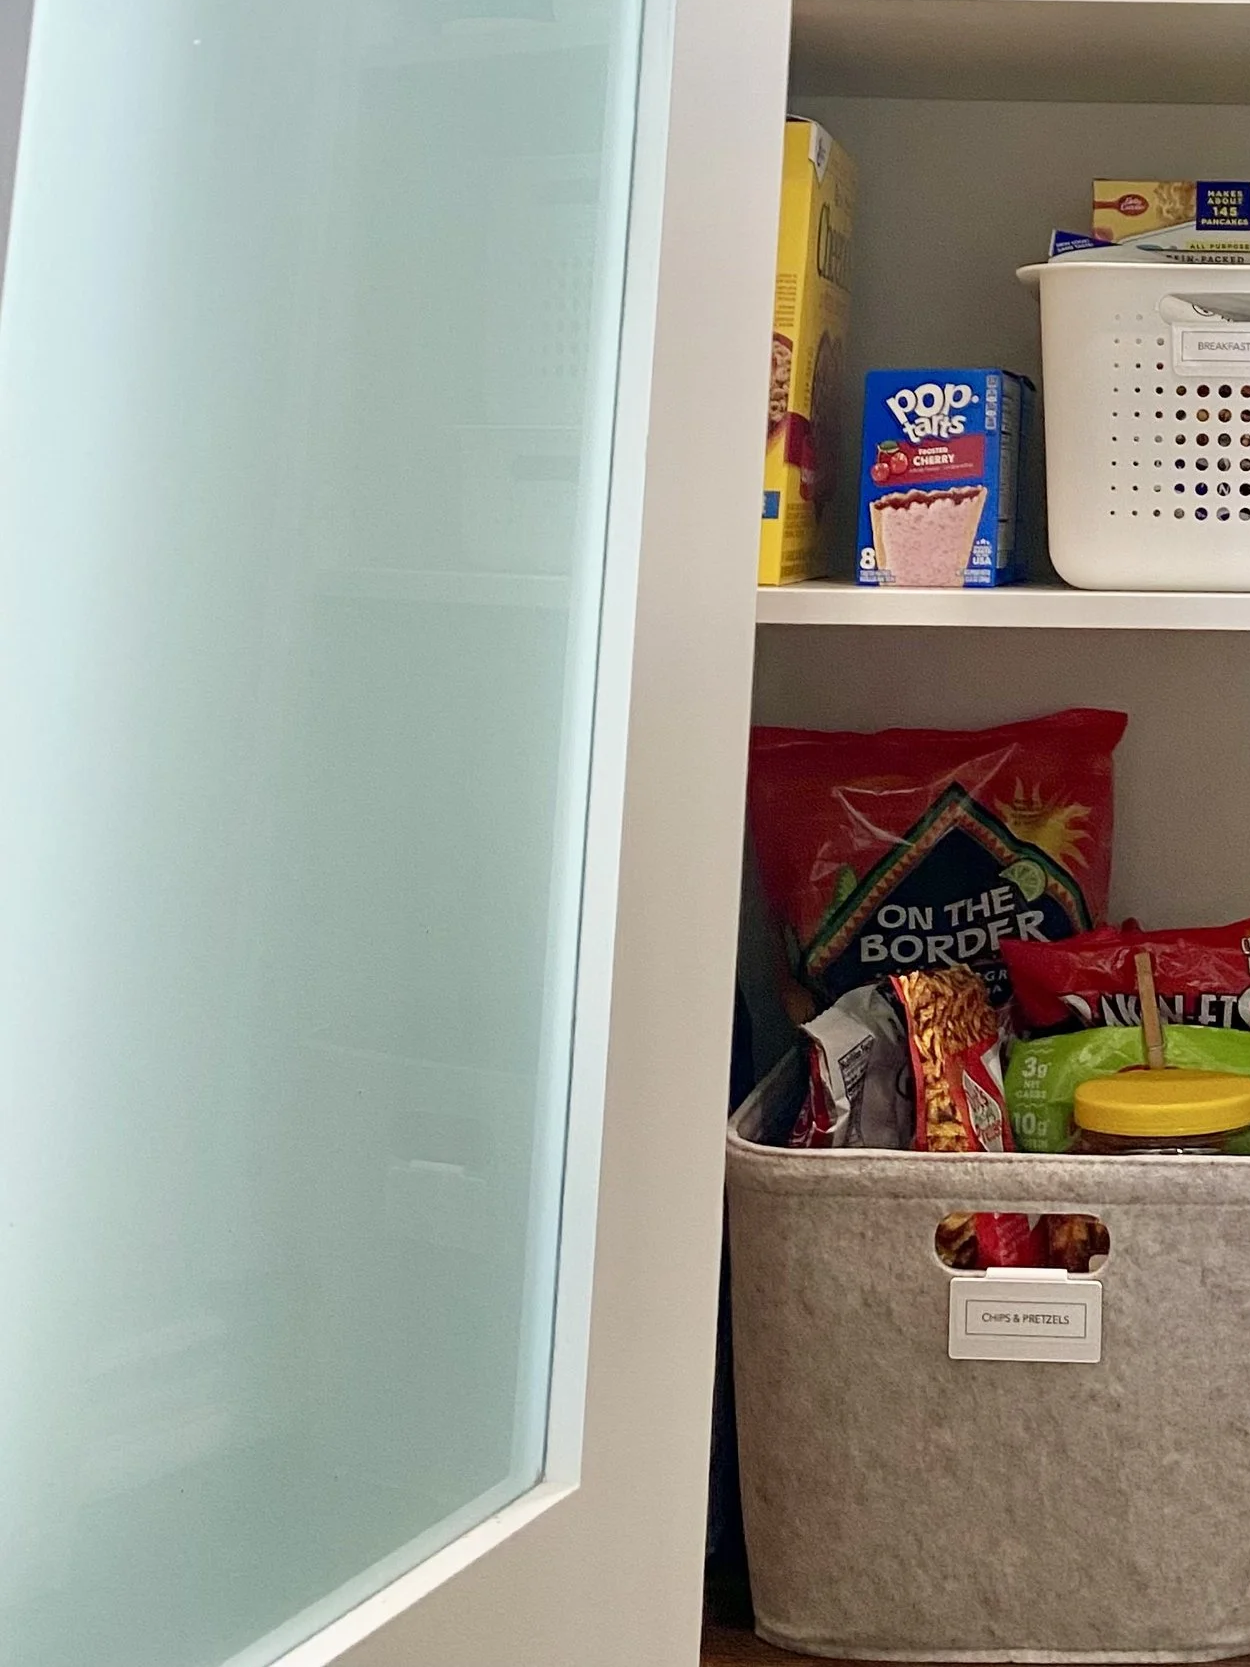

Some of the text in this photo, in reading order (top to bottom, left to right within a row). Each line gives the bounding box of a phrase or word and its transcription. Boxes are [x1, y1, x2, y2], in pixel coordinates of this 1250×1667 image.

[1207, 197, 1243, 205] ABOUT
[1213, 206, 1238, 216] 145
[1201, 218, 1249, 226] PANCAKES
[1166, 254, 1245, 263] EIN-PACKED
[918, 446, 949, 455] FROSTED
[912, 454, 955, 466] CHERRY
[860, 547, 876, 570] 8
[877, 885, 1016, 931] ON THE
[860, 910, 1052, 967] BORDER
[981, 1312, 1070, 1325] CHIPS & PRETZELS
